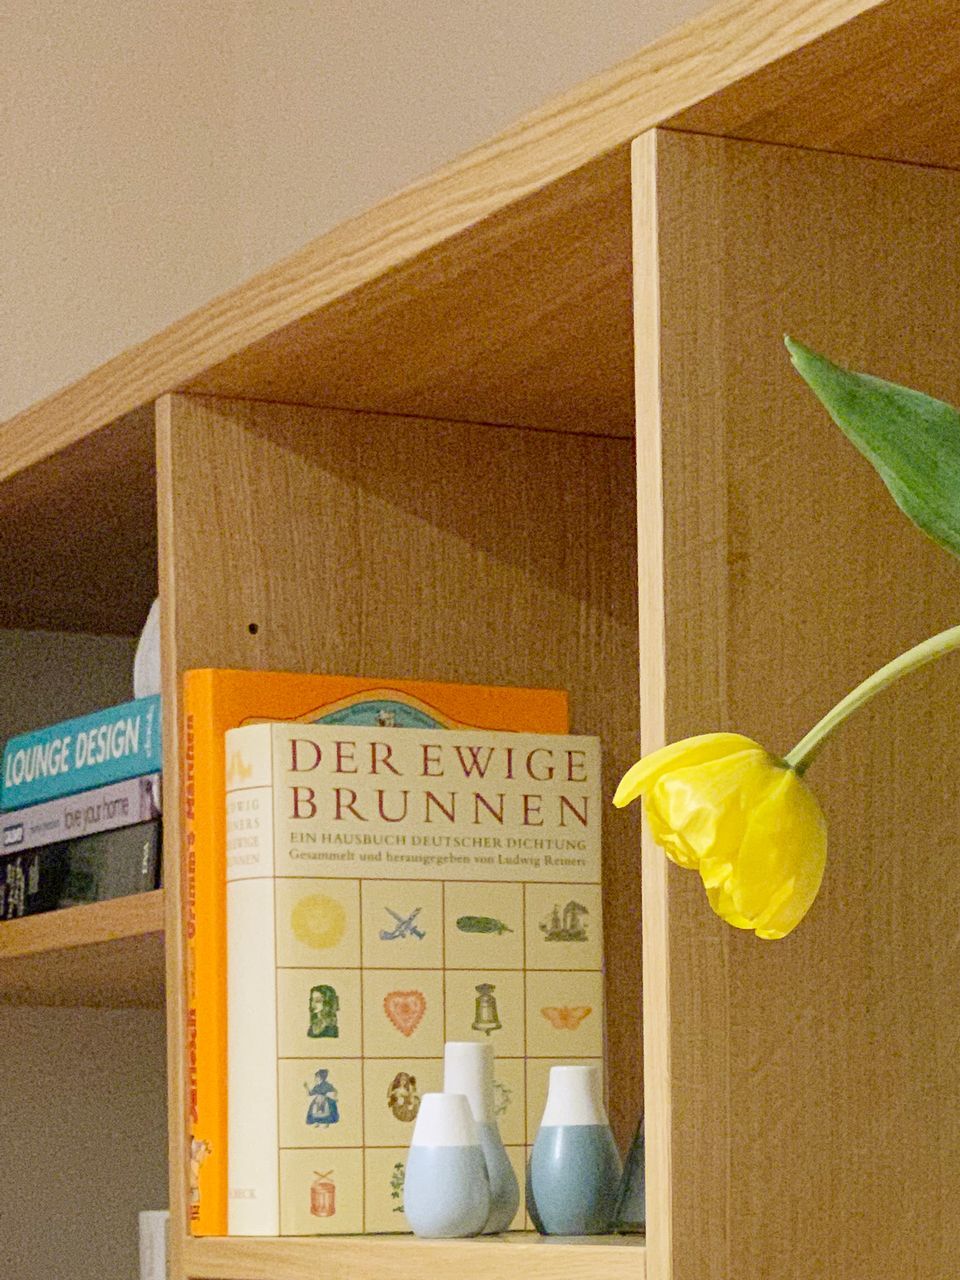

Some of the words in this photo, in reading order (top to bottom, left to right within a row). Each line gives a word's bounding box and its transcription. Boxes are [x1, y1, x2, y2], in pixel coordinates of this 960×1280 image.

[5, 736, 71, 788] LOUNGE
[75, 715, 141, 769] DESIGN
[287, 738, 403, 777] DER
[419, 744, 589, 782] EWIGE
[288, 785, 590, 828] BRUNNEN
[288, 849, 355, 862] Gesammelt
[360, 852, 383, 862] und
[386, 851, 470, 866] herausgegeben
[474, 855, 494, 865] von
[498, 854, 541, 868] Ludwig
[290, 831, 317, 844] EIN
[321, 832, 406, 846] HAUSBUCH
[411, 835, 502, 849] DEUTSCHER
[506, 838, 587, 851] DICHTUNG
